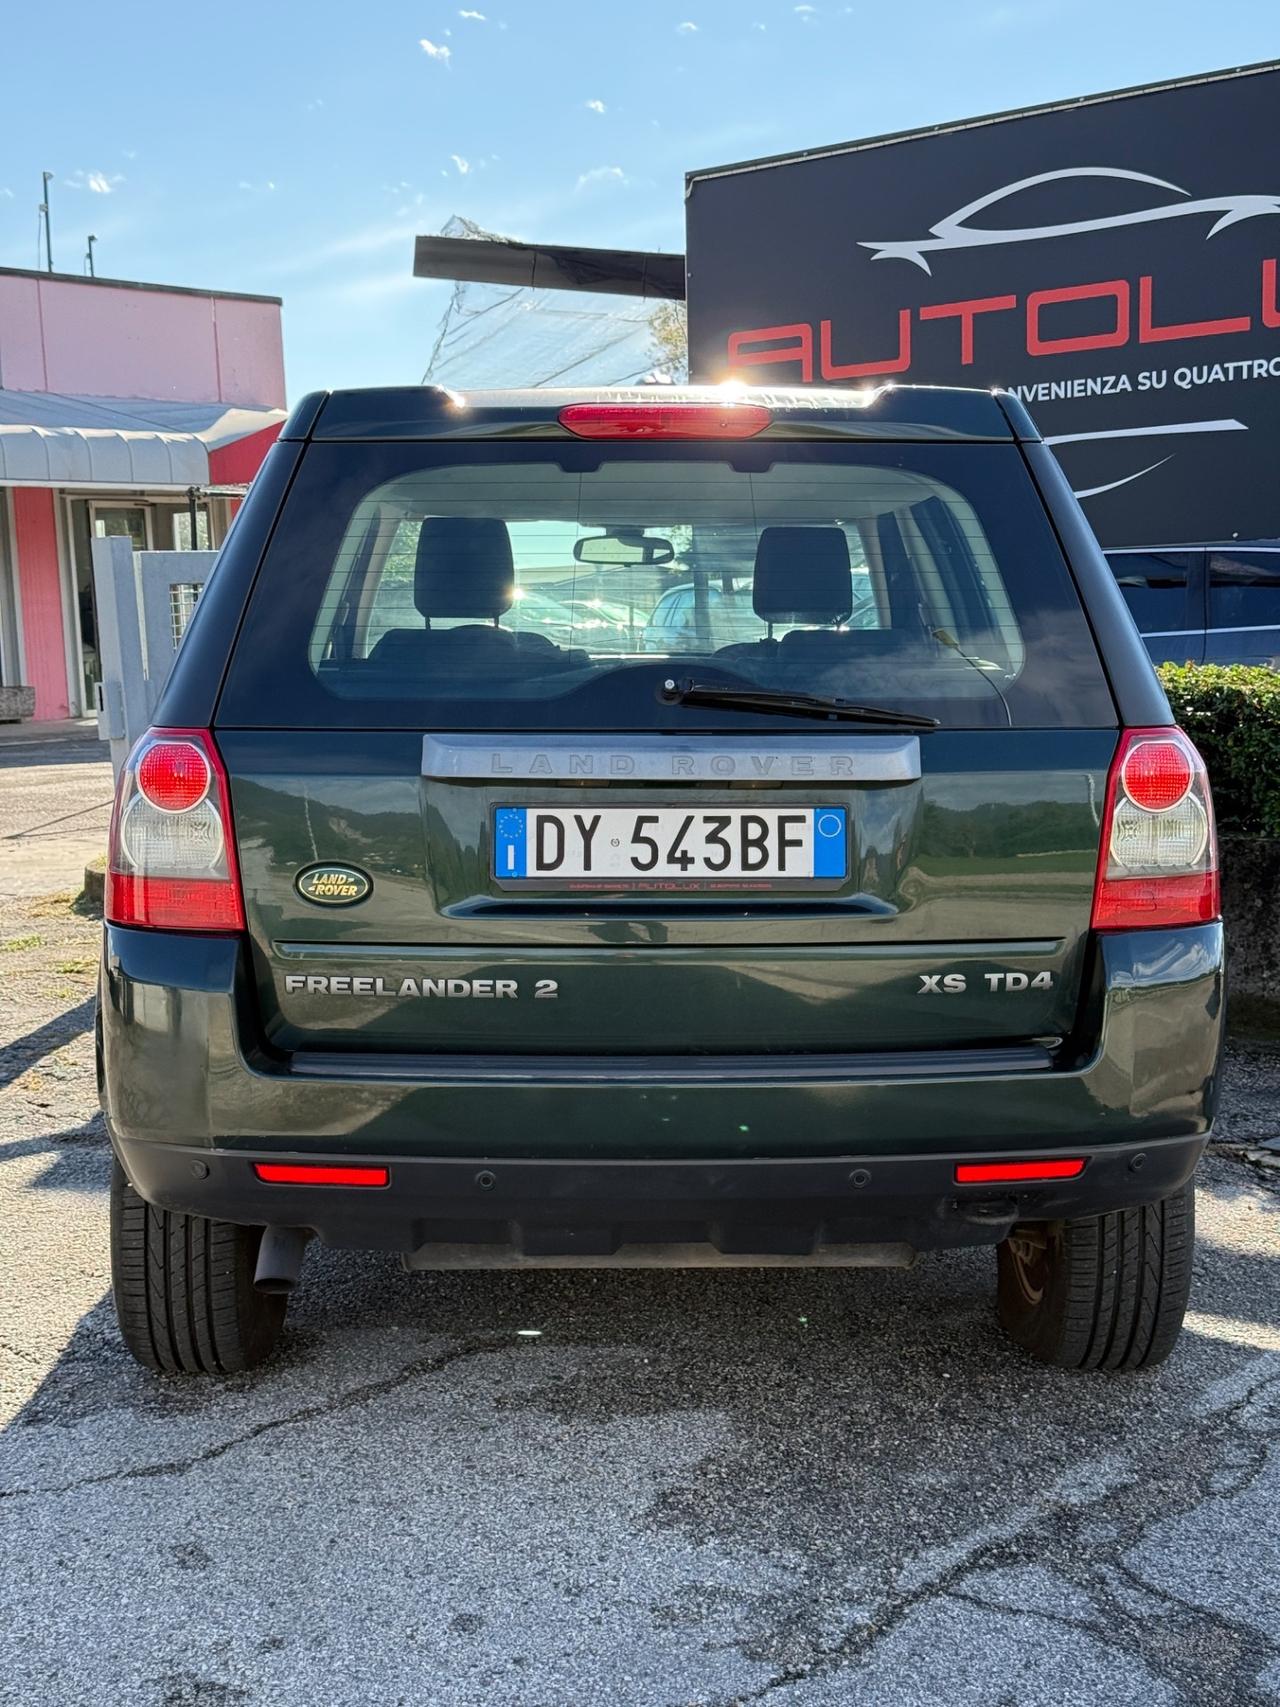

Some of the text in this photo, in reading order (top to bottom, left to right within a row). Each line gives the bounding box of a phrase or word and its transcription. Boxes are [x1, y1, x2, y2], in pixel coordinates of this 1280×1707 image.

[727, 259, 1280, 383] AUTOL
[1138, 369, 1168, 390] SU
[491, 754, 856, 776] LAND ROVER
[535, 814, 807, 872] DY 543BF
[285, 975, 560, 999] FREELANDER 2
[917, 971, 1054, 994] XS TD4
